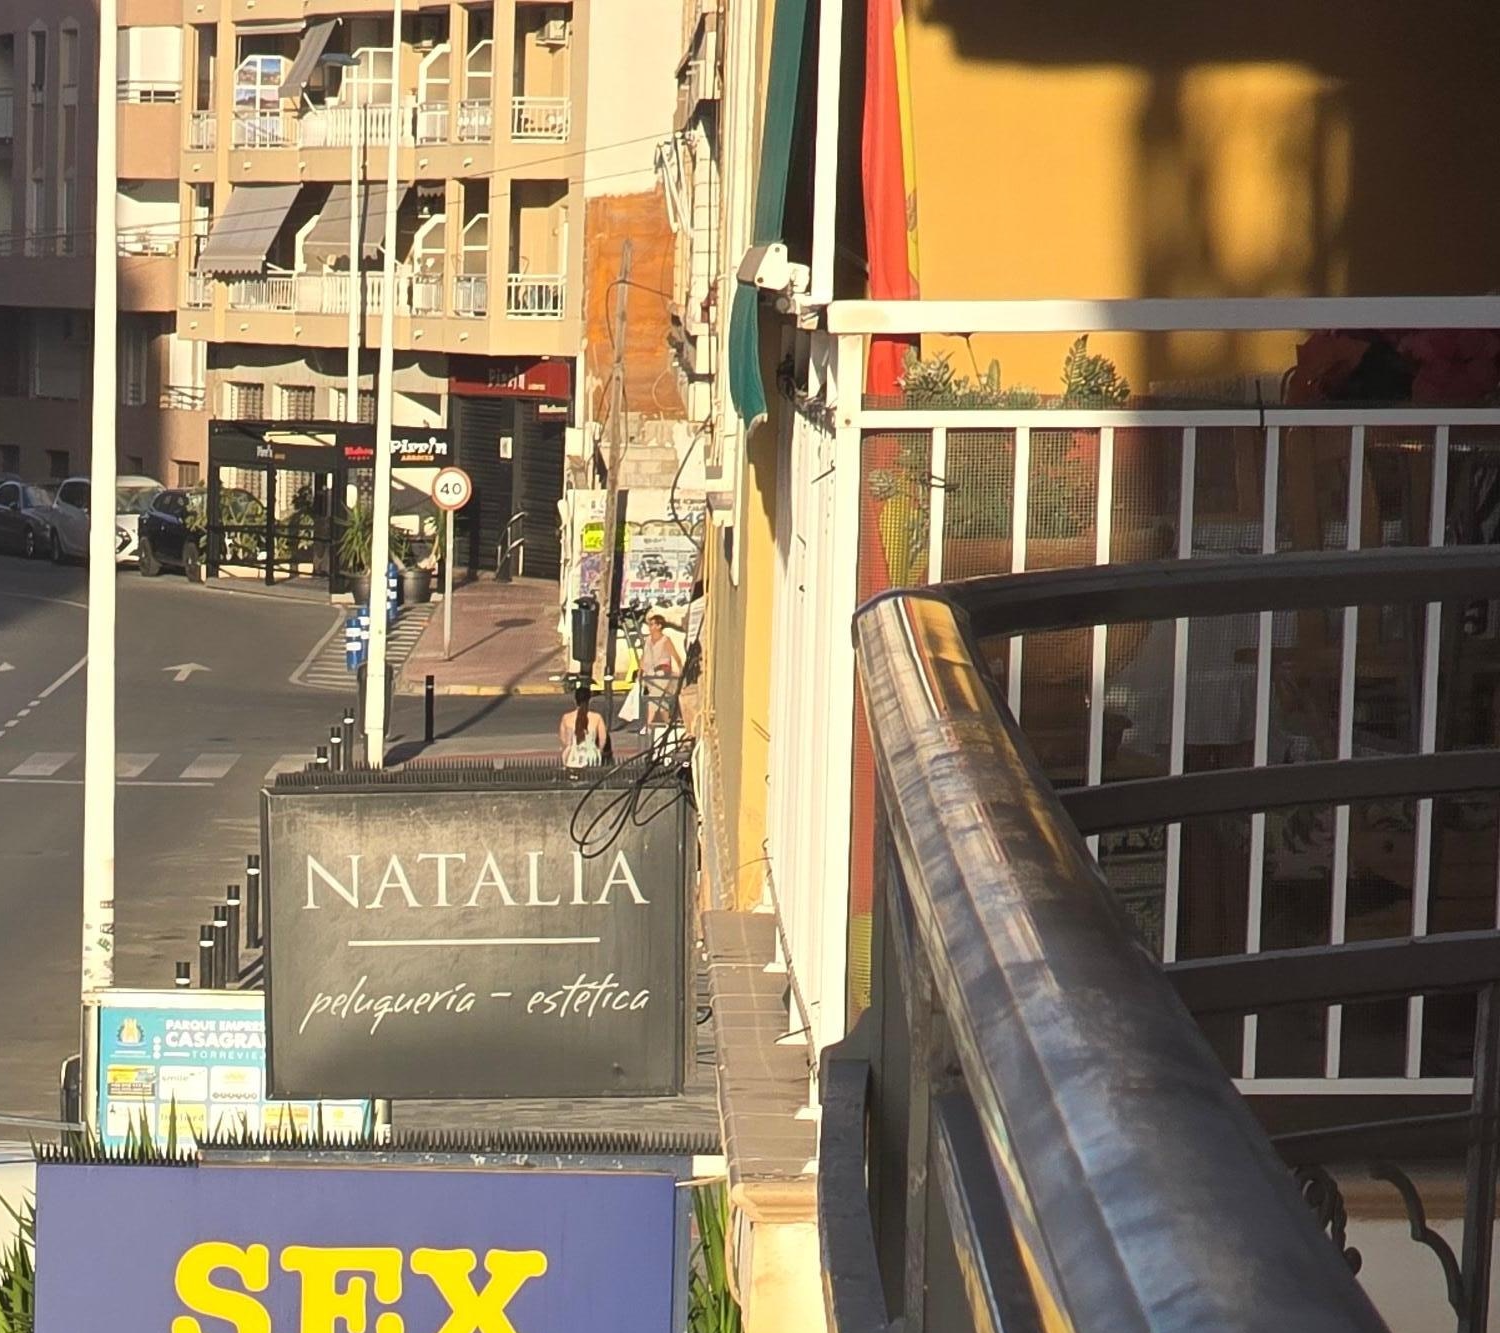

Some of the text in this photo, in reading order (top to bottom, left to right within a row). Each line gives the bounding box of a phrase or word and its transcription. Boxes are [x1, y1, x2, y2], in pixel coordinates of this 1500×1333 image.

[440, 483, 462, 495] 40
[302, 850, 650, 910] NATALIA
[299, 975, 477, 1036] peluquería
[526, 973, 651, 1018] estética
[165, 1019, 216, 1031] PARQUE
